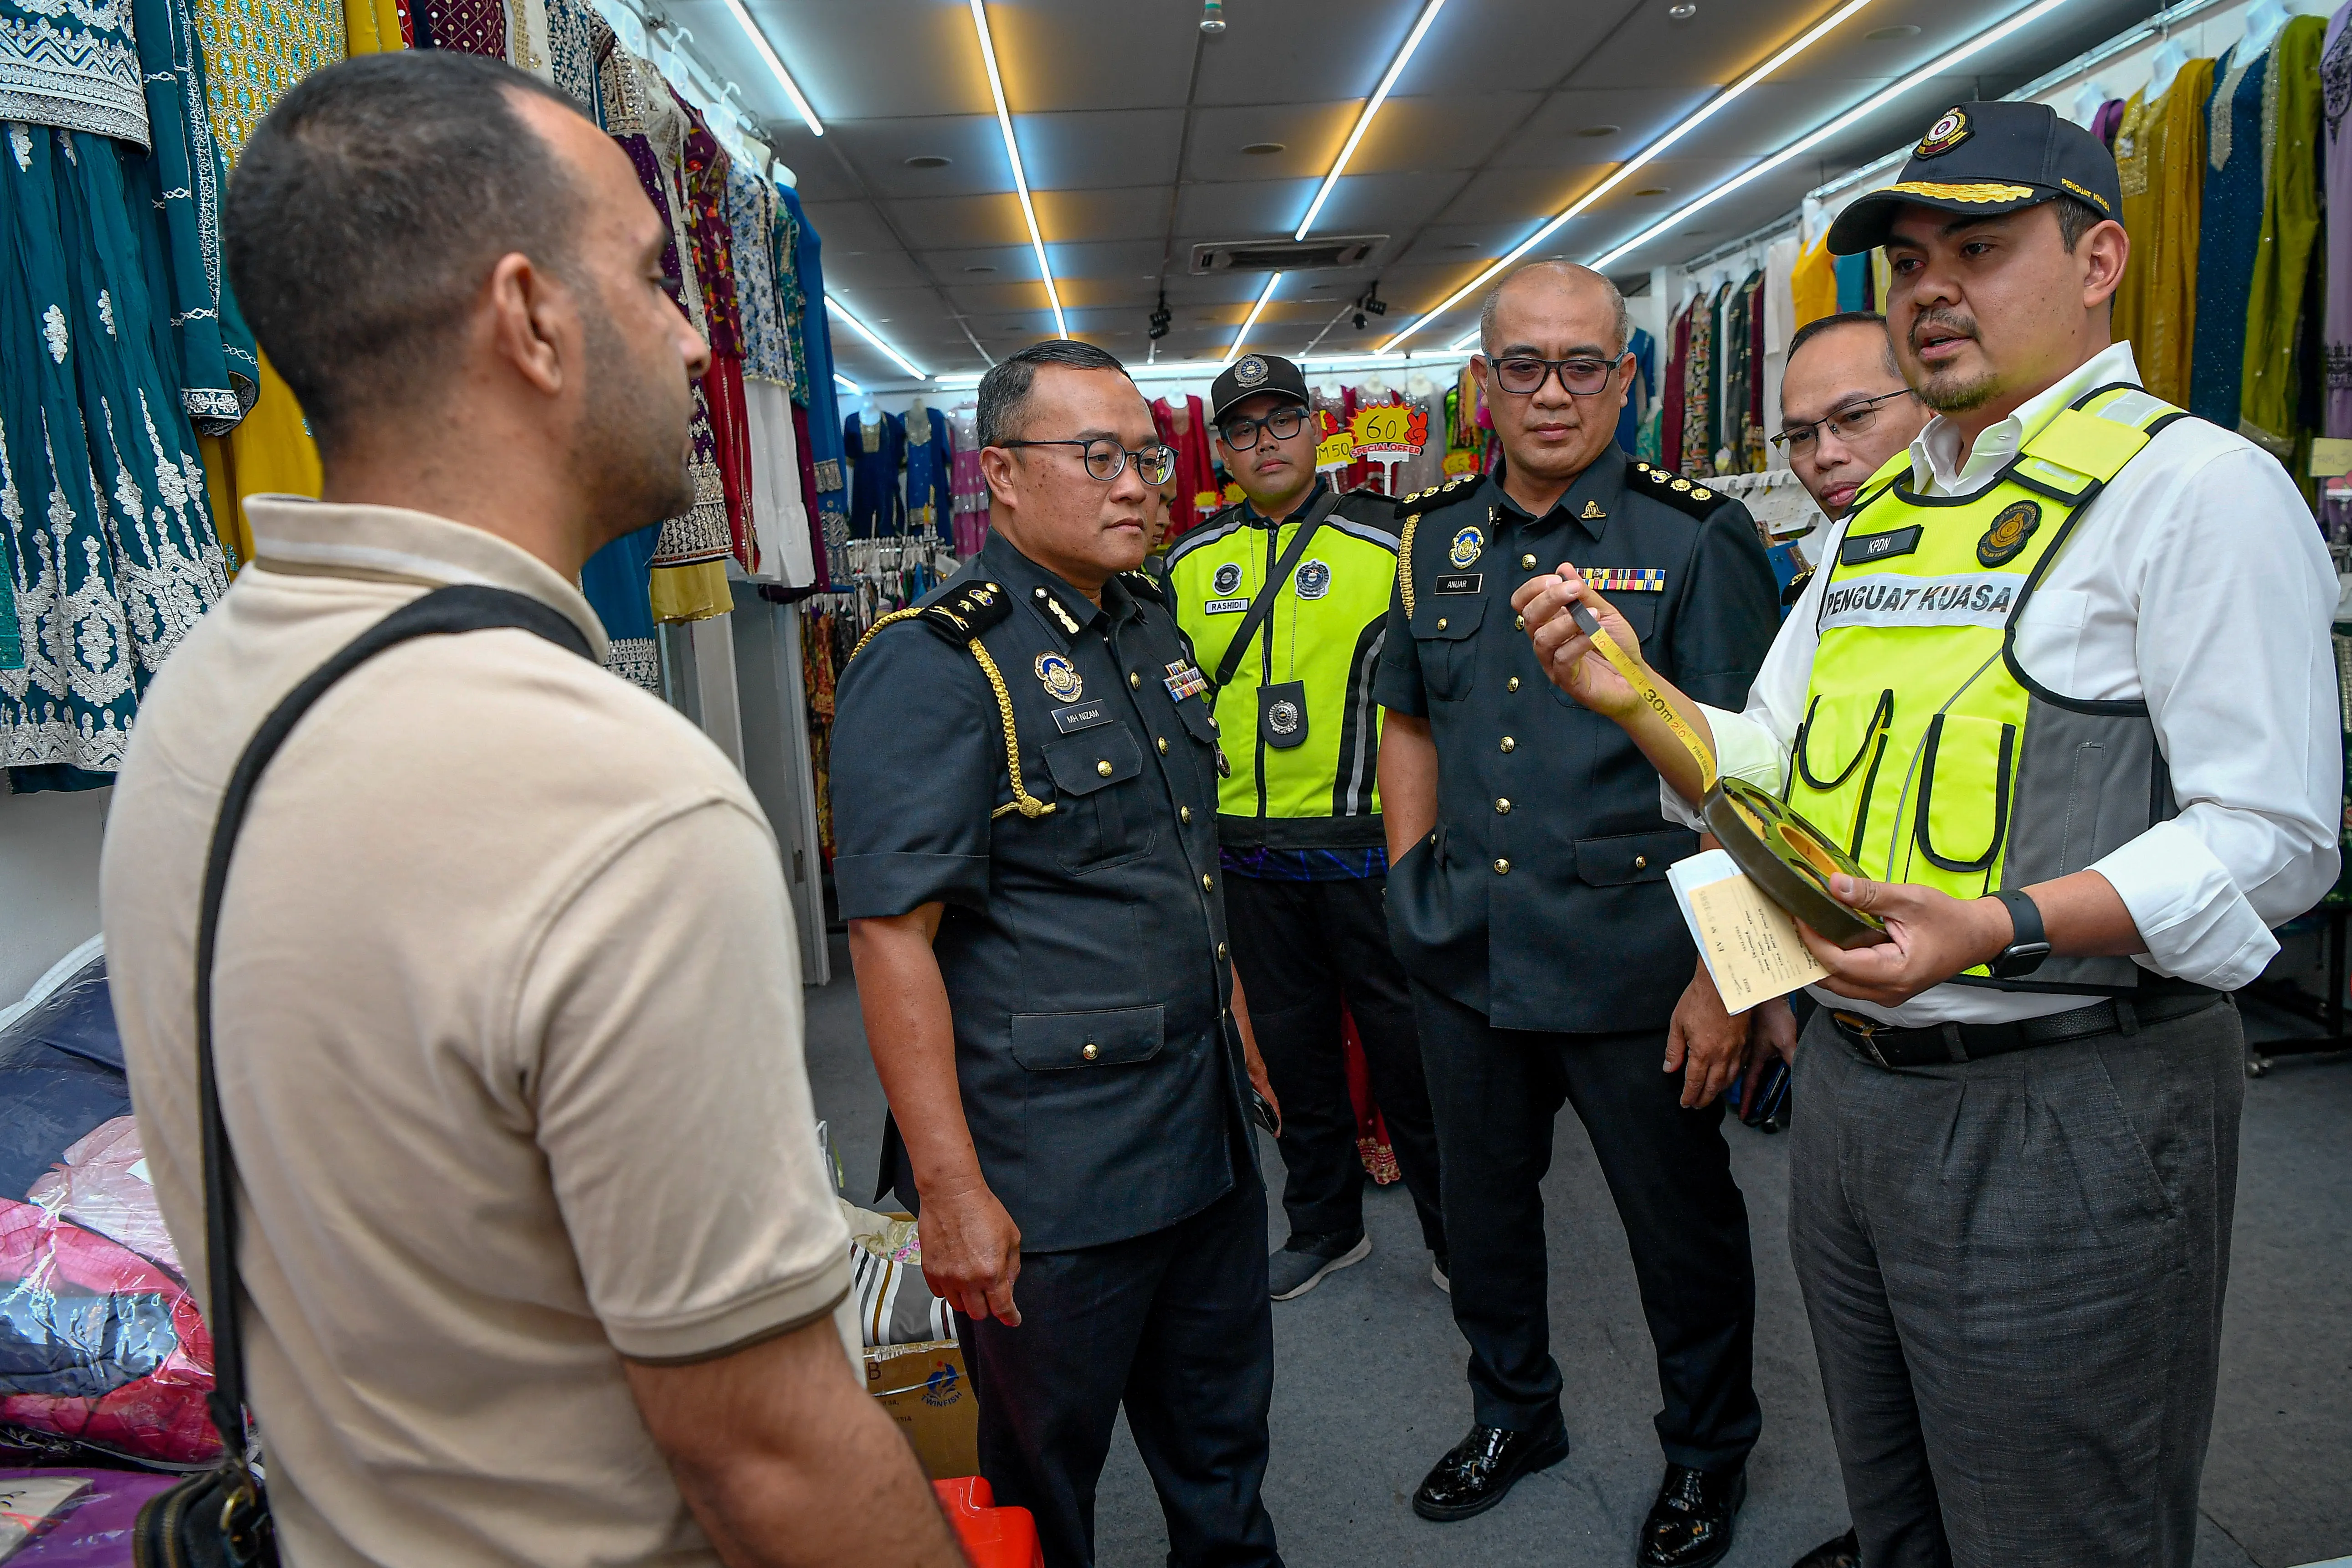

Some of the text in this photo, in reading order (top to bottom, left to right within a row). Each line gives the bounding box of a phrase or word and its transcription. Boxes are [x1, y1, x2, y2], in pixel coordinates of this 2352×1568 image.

[2061, 178, 2091, 197] PENGUAT
[1366, 415, 1397, 439] 60
[1351, 443, 1421, 457] SPECIAL OFFER
[1867, 537, 1891, 555] KPDN
[1447, 580, 1467, 588] ANUAR
[1212, 601, 1242, 611] RASHIDI
[1824, 584, 2012, 618] PENGUAT KUASA
[1643, 689, 1673, 722] 30m
[1066, 709, 1100, 724] MH NIZAM
[1670, 722, 1686, 738] 20
[868, 1362, 881, 1380] B
[921, 1392, 962, 1407] TWINFISH
